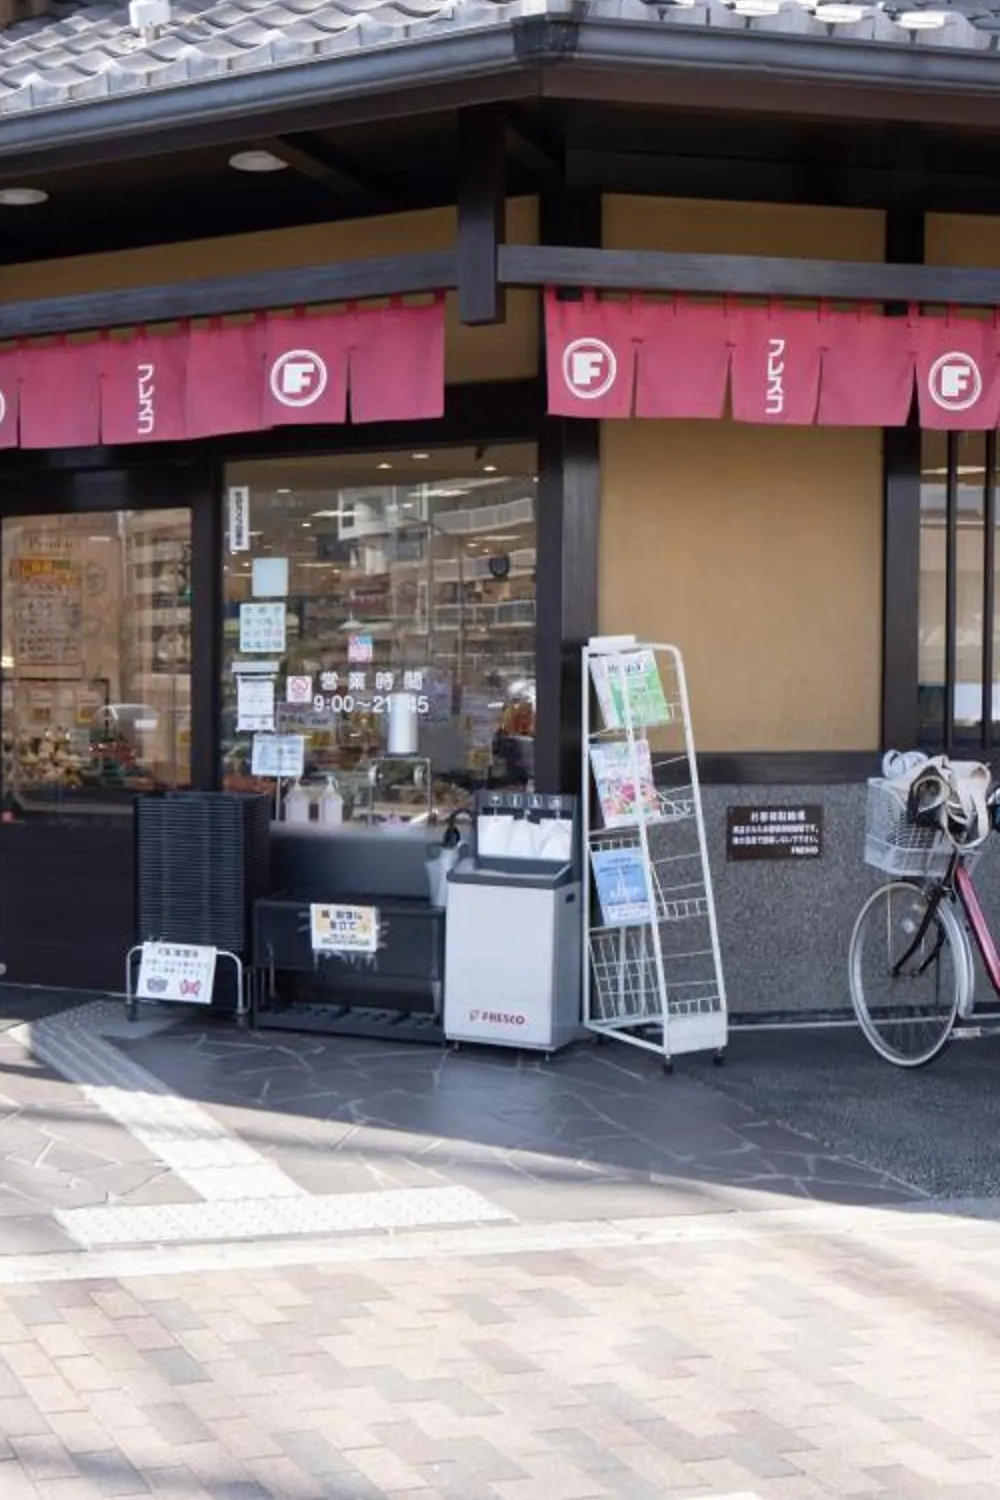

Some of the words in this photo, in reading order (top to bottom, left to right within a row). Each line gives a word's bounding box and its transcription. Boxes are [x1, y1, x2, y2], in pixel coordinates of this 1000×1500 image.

[136, 363, 154, 434] フレスコ
[765, 338, 785, 414] フレスコ
[320, 671, 423, 691] 営業時間
[482, 1011, 525, 1025] FRESCO
